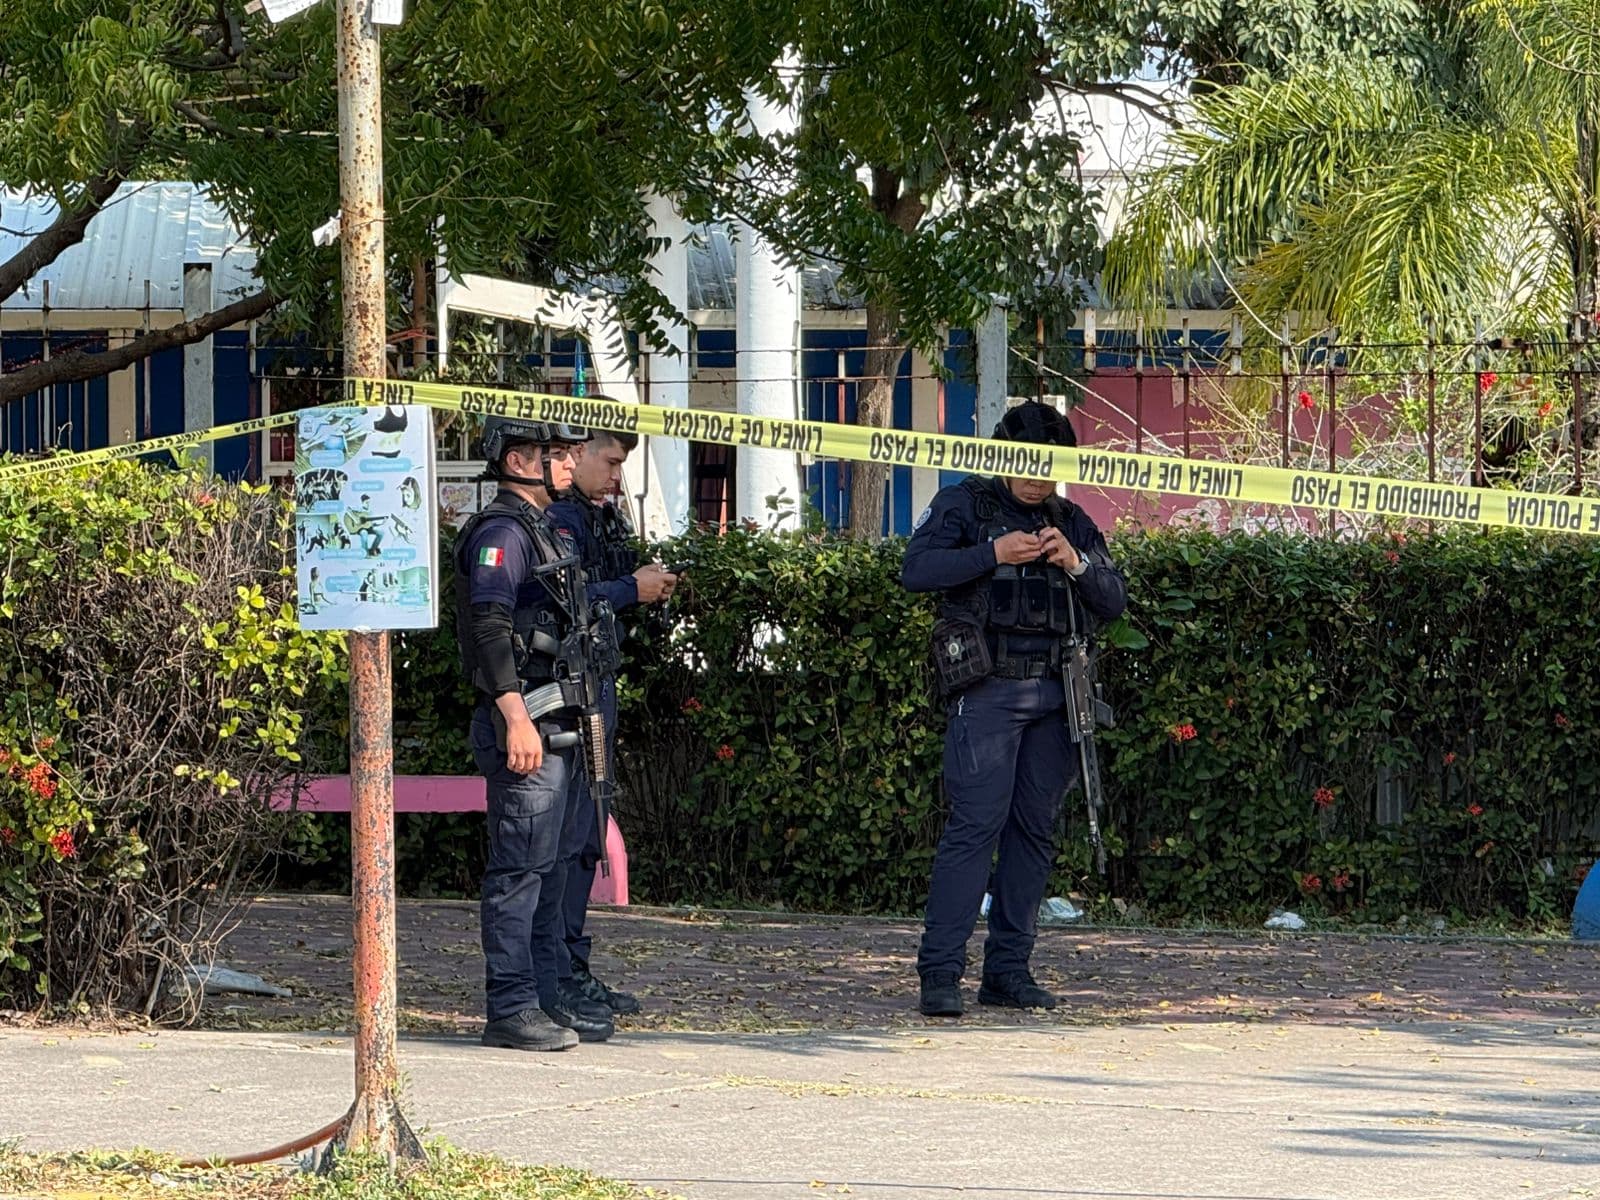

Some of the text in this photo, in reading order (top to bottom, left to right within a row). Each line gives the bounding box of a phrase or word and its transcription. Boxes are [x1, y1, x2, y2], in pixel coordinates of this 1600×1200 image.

[363, 380, 414, 405] LINEA
[461, 391, 639, 431] PROHIBIDO EL PASO
[663, 410, 823, 452] LINEA DE POLICIA
[870, 432, 1053, 477] PROHIBIDO EL PASO
[1078, 453, 1243, 497] LINEA DE POLICIA
[1291, 475, 1481, 520] PROHIBIDO EL PASO
[1507, 496, 1583, 530] POLICIA
